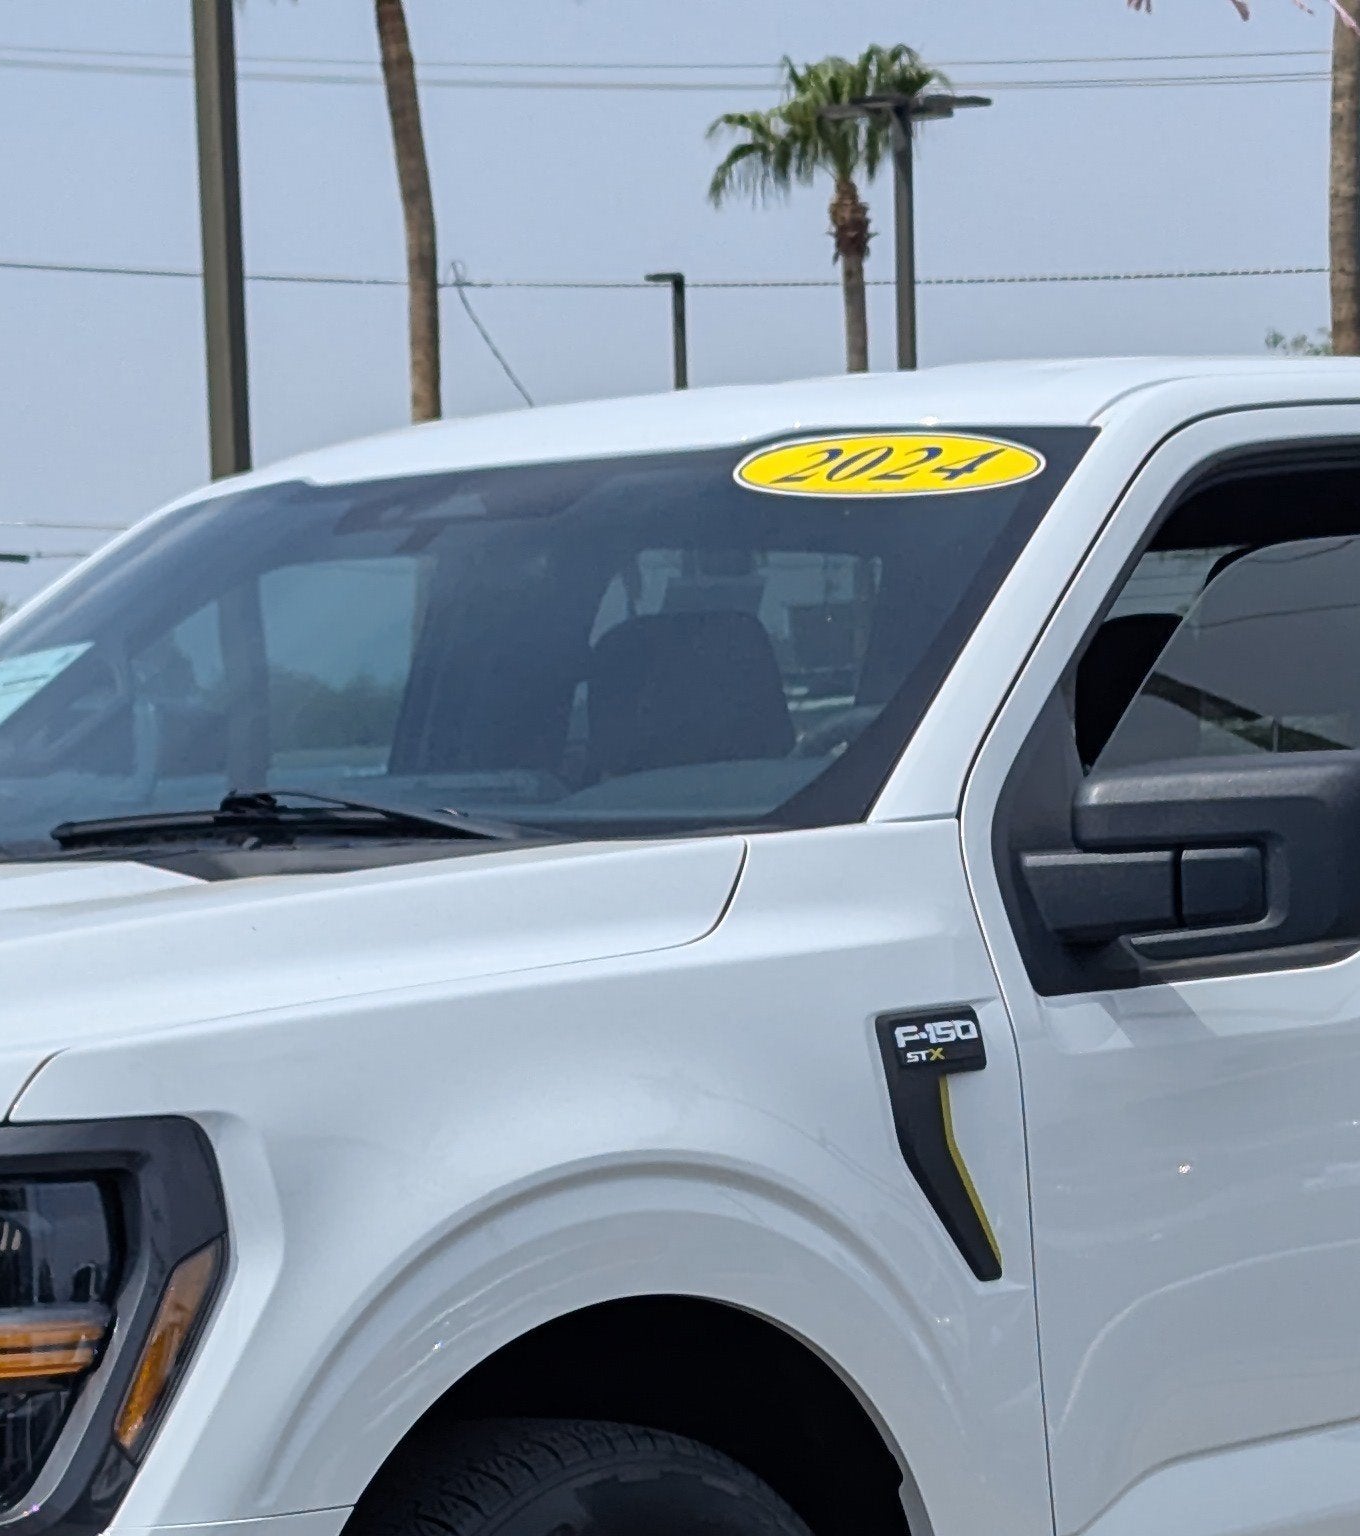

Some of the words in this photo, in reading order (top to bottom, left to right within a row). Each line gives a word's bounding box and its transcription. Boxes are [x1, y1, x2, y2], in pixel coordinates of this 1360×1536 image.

[768, 446, 1007, 484] 2024
[894, 1020, 979, 1048] F-150
[906, 1047, 945, 1063] STX
